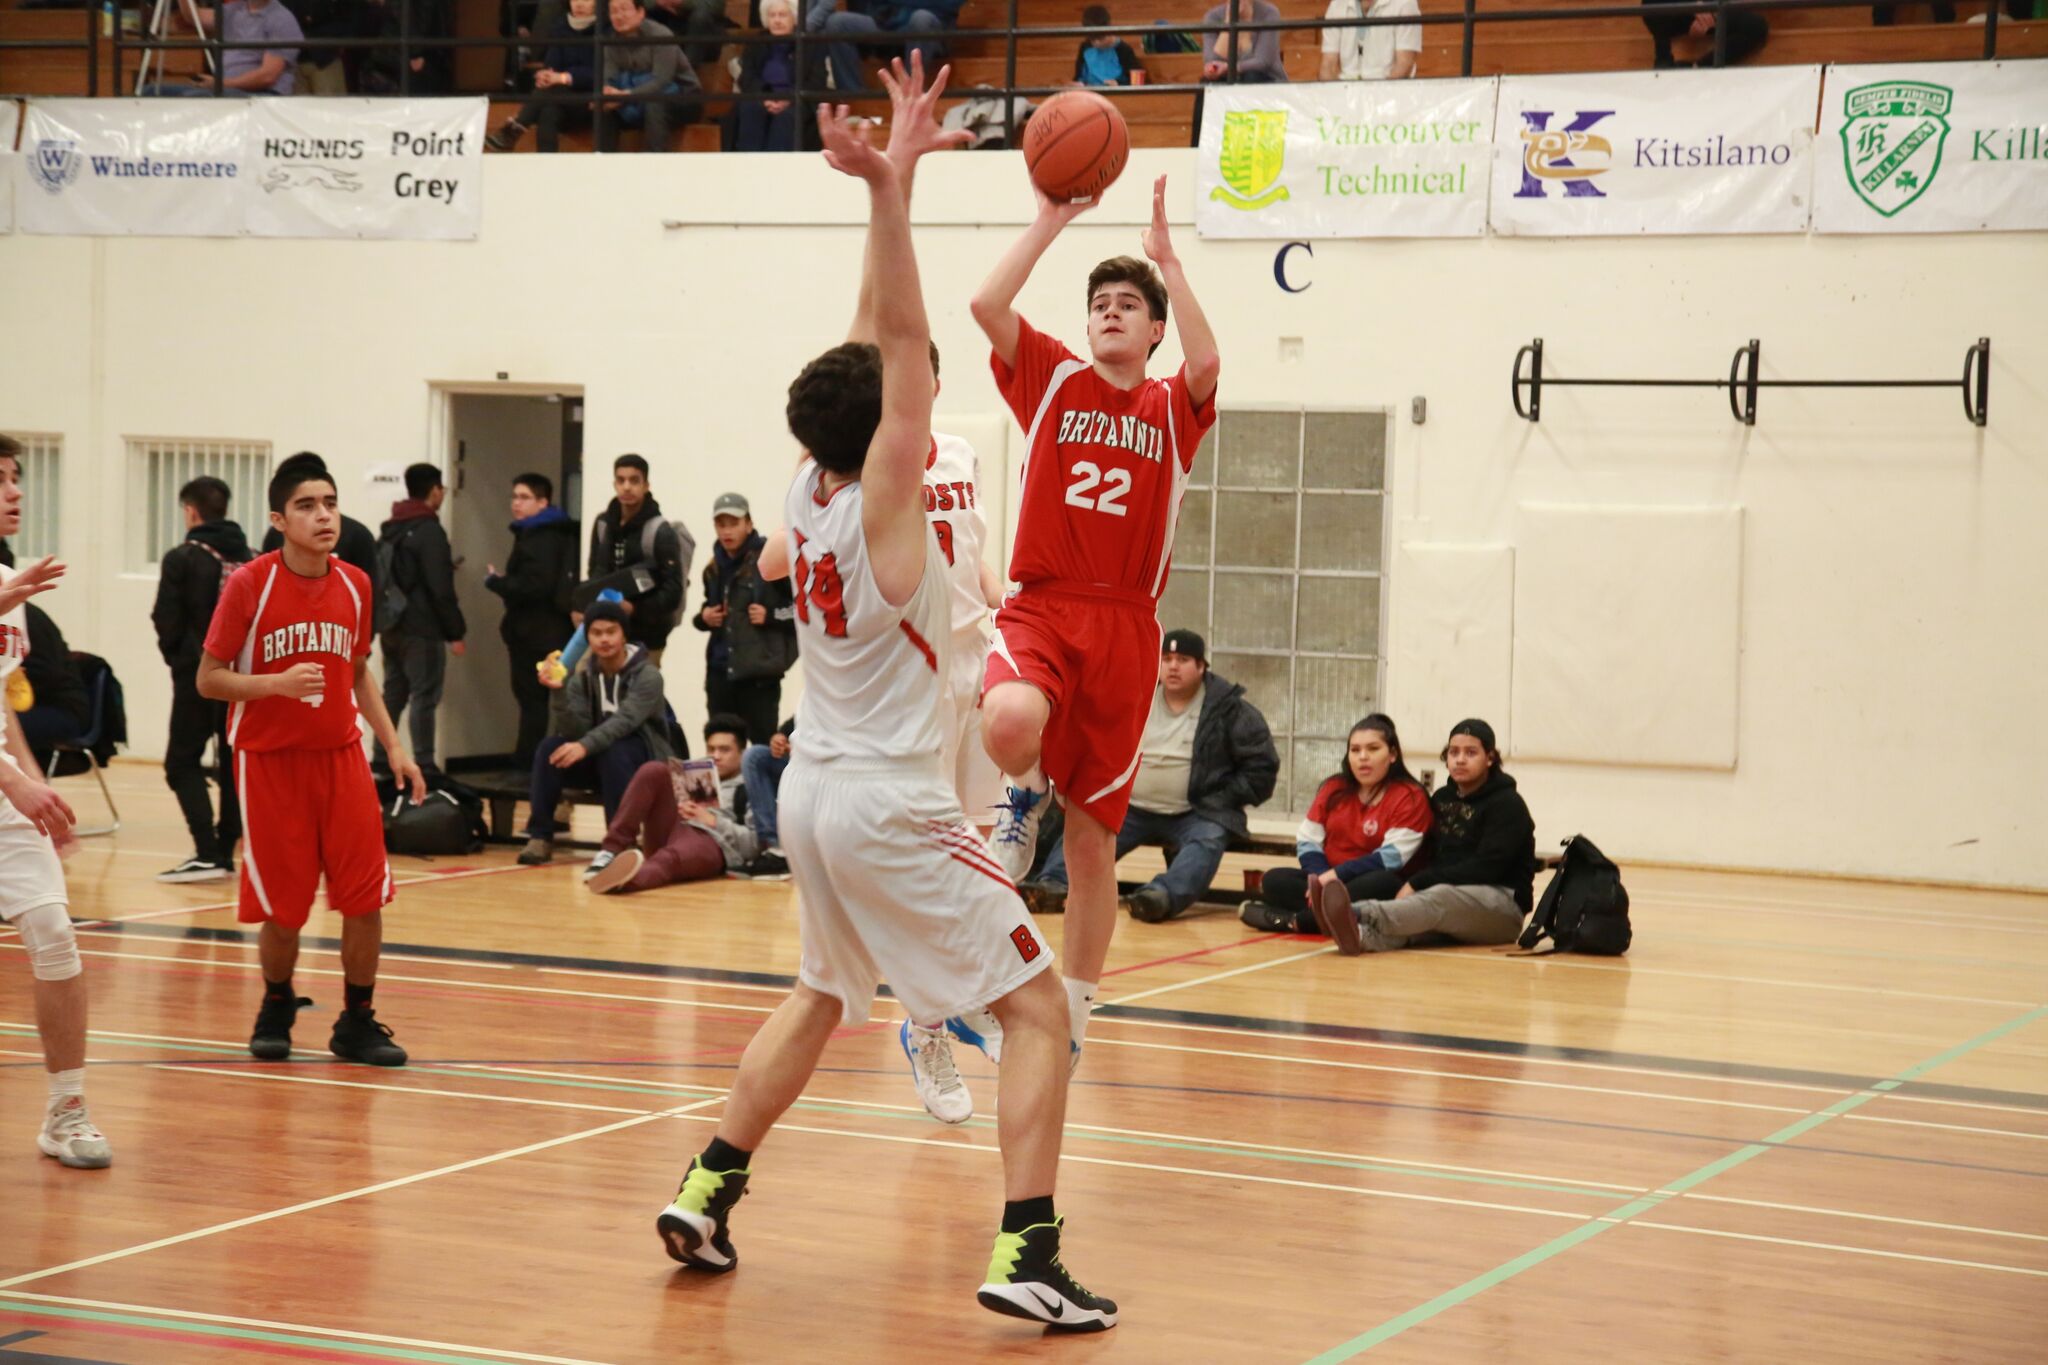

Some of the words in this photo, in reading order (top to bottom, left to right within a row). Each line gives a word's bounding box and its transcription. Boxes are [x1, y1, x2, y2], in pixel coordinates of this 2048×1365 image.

[265, 137, 365, 160] HOUNDS
[391, 130, 465, 158] Point
[1316, 117, 1480, 146] Vancouver
[90, 155, 238, 179] Windermere
[1633, 135, 1791, 169] Kitsilano
[1862, 121, 1936, 192] KILLARNEY
[394, 173, 459, 205] Grey
[1317, 163, 1467, 197] Technical
[1273, 241, 1314, 294] C
[1057, 410, 1163, 464] BRITANNIA
[1065, 460, 1132, 517] 22
[1009, 924, 1041, 964] B
